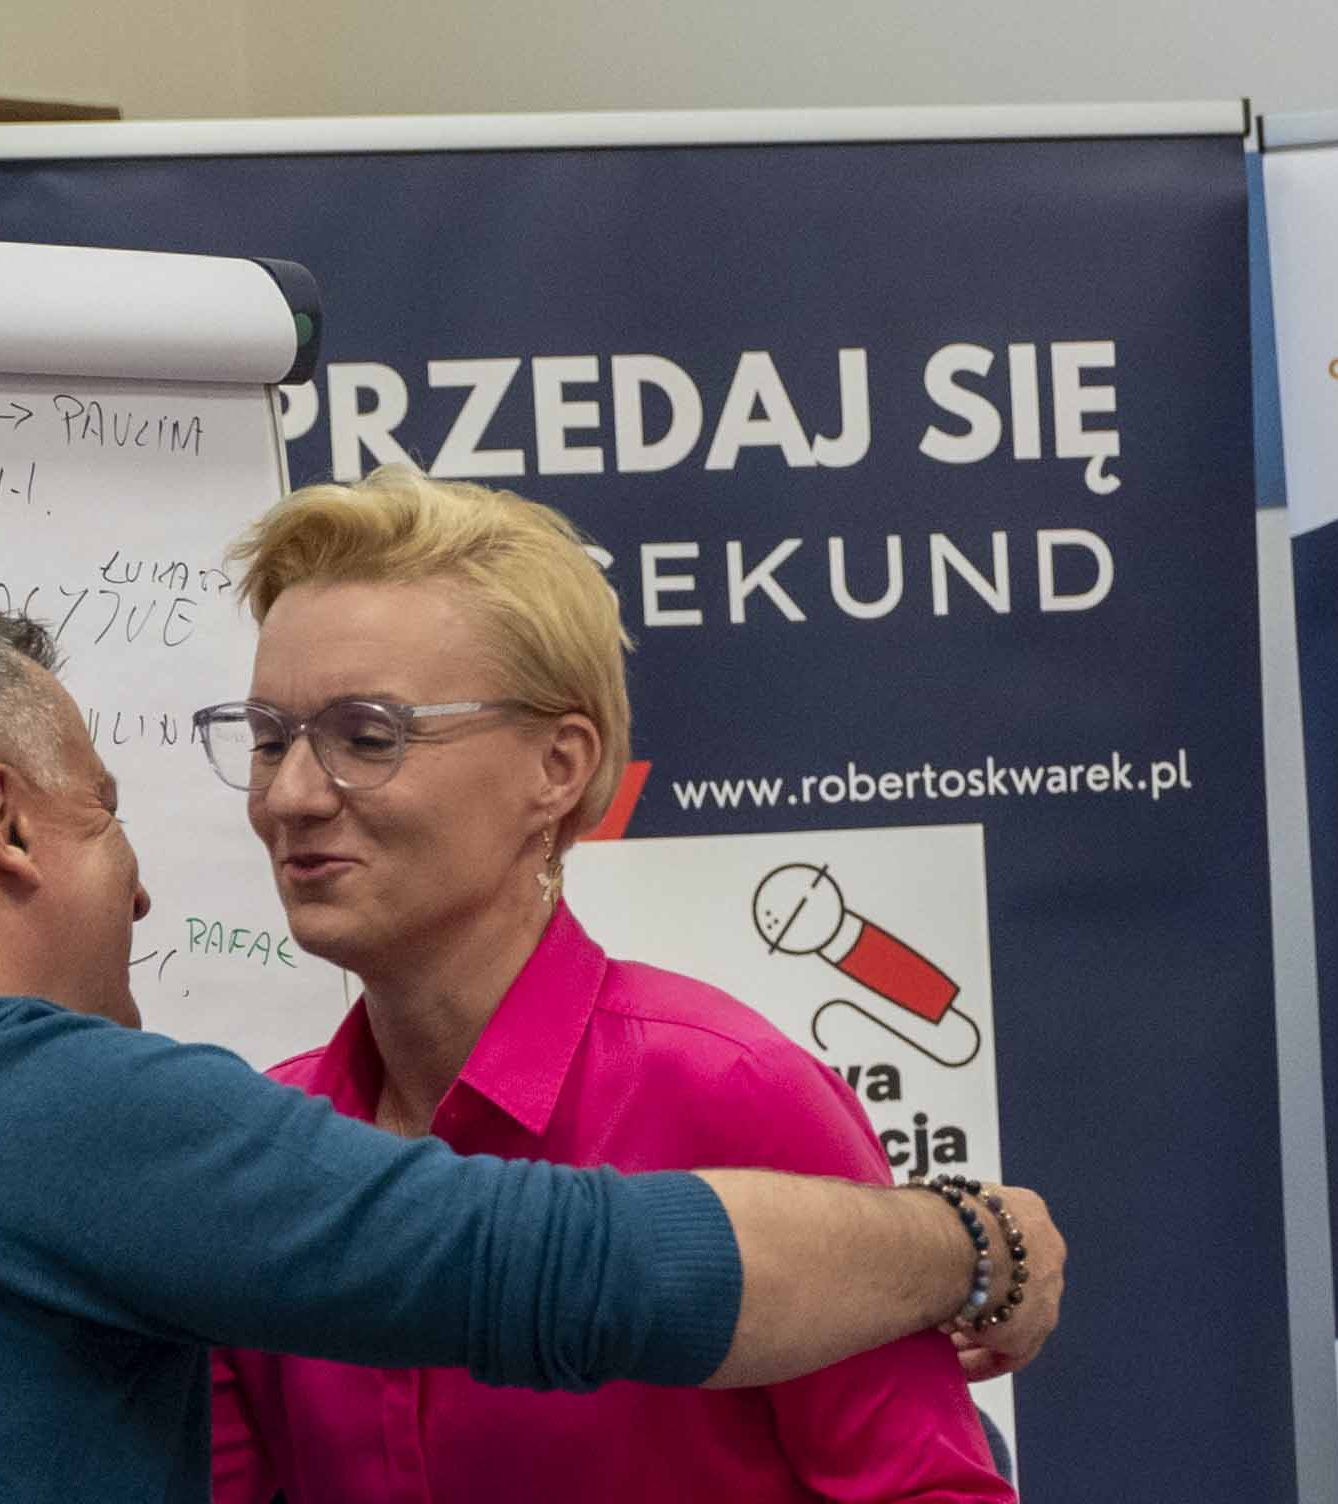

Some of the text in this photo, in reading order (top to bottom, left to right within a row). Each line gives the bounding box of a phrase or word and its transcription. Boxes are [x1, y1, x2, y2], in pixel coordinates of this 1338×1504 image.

[919, 341, 1121, 494] SIĘ
[584, 528, 1115, 627] EKUND
[672, 749, 1191, 810] www.robertoskwarek.pl
